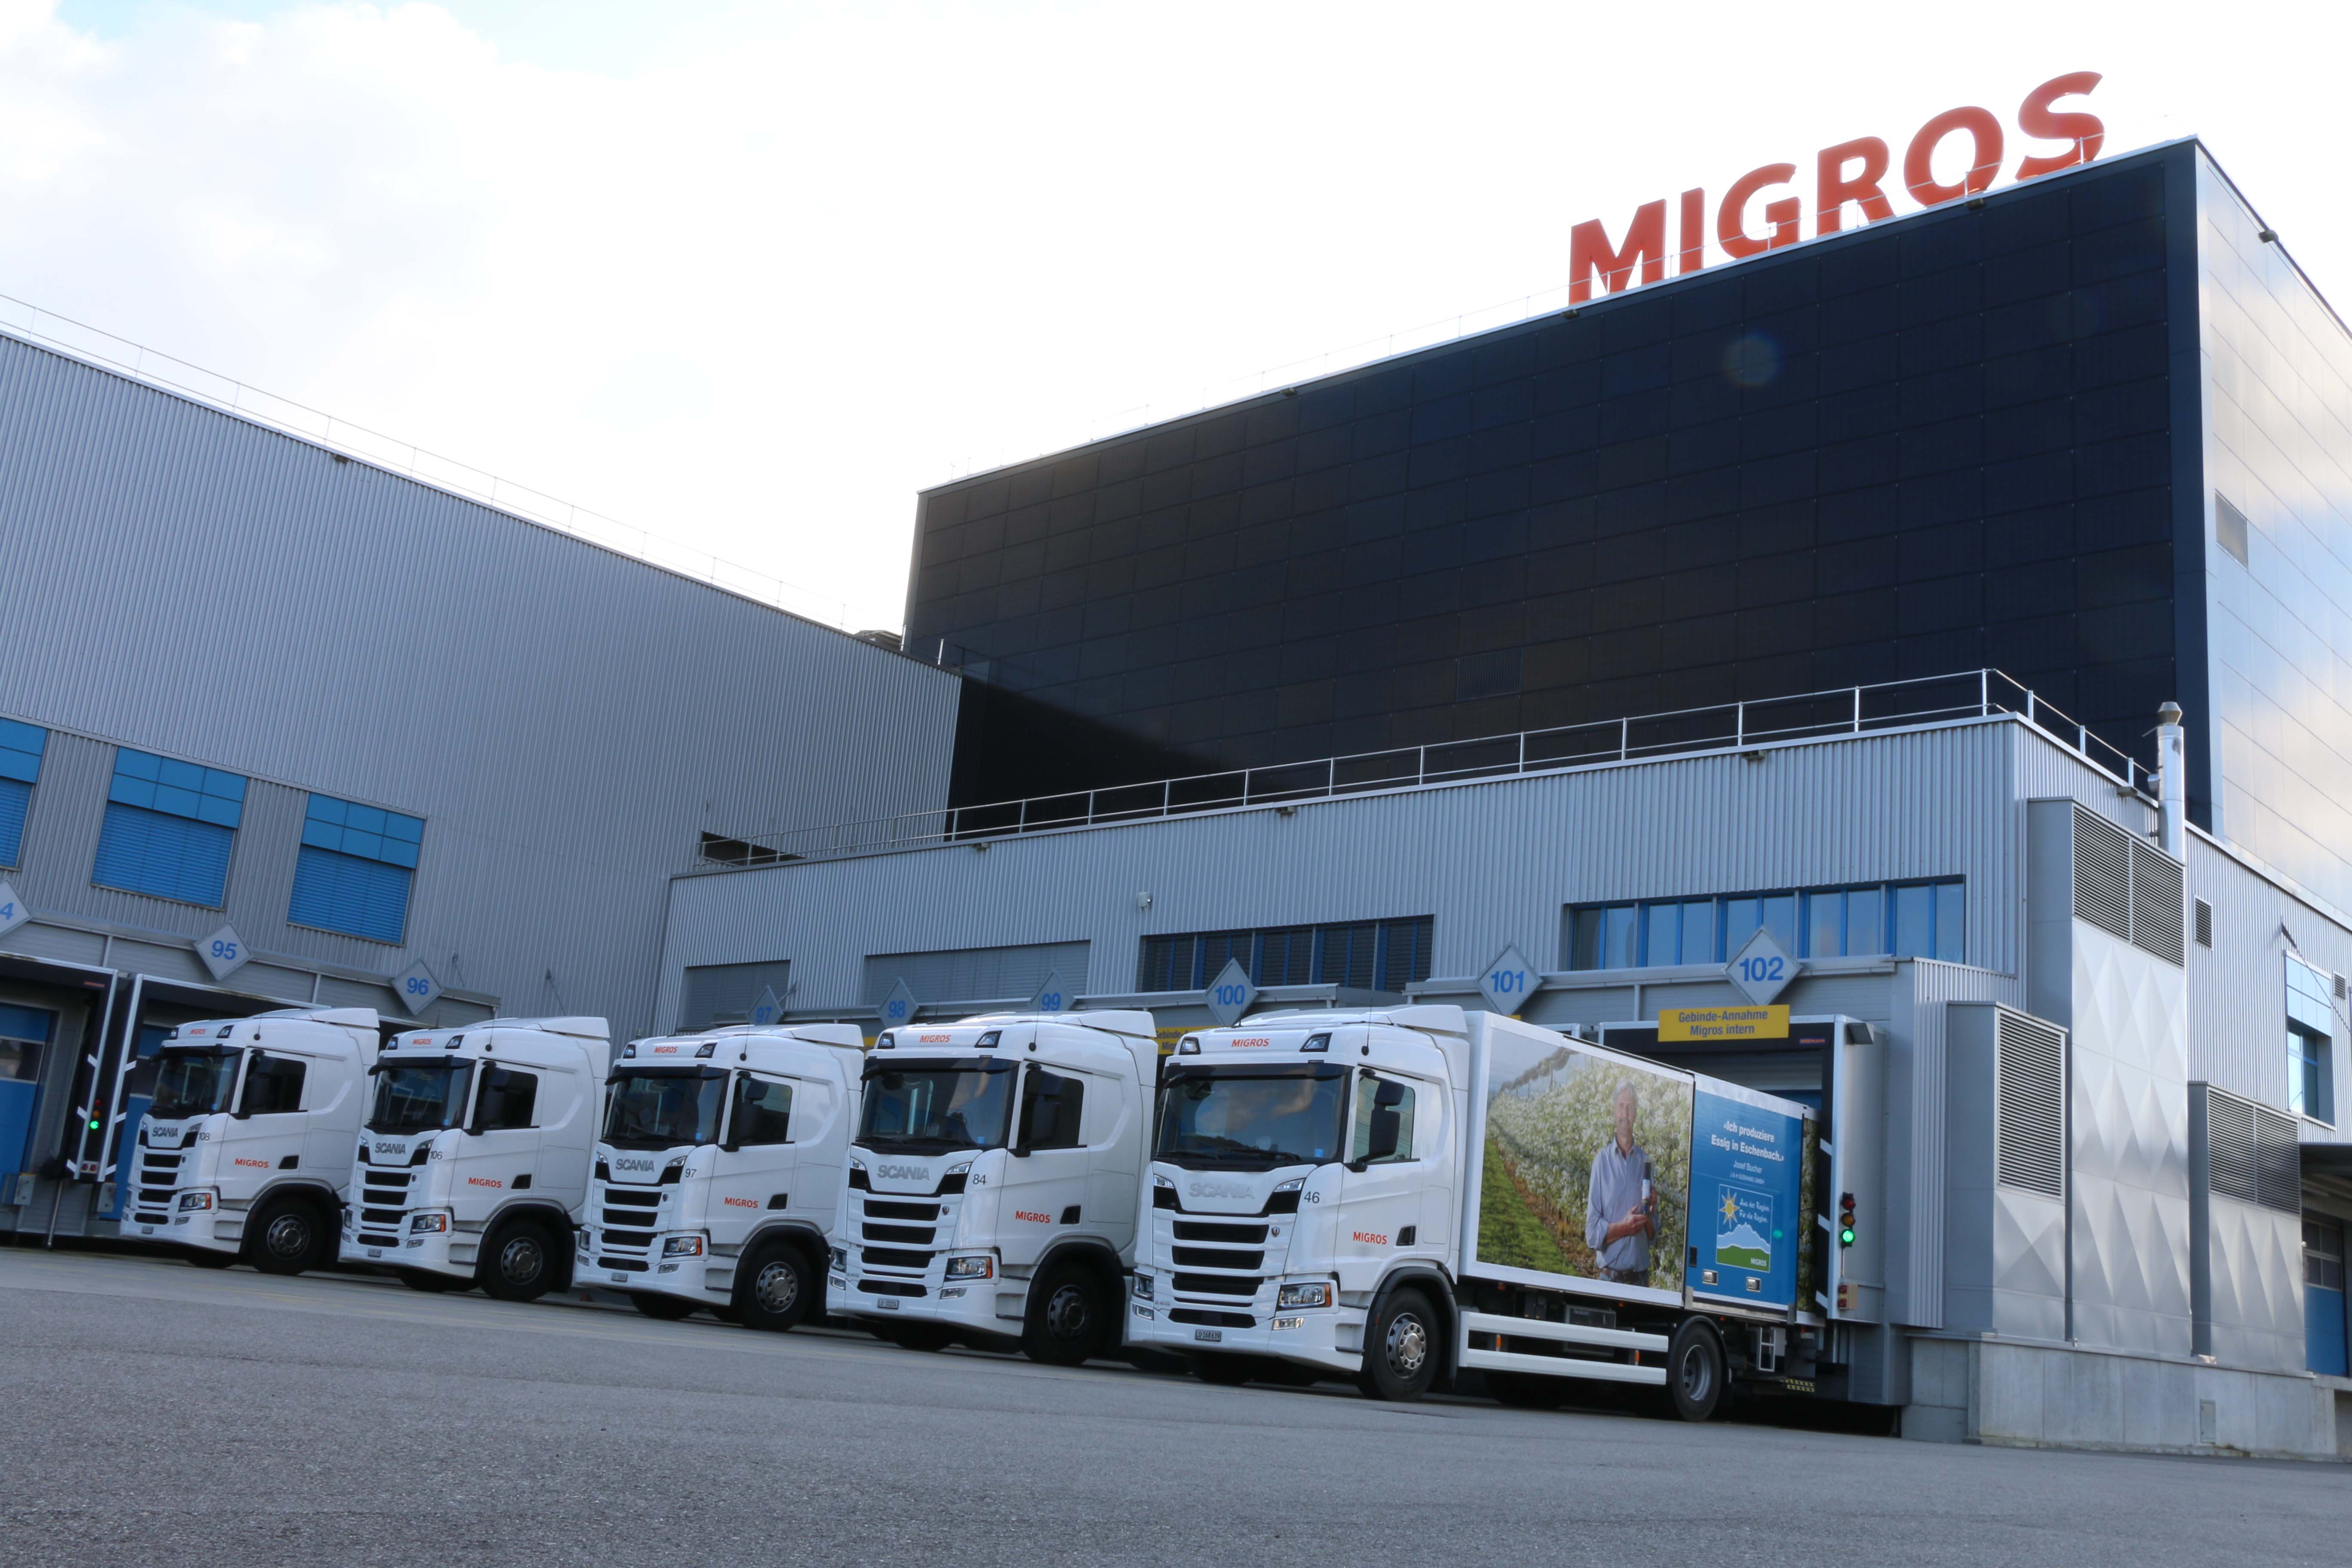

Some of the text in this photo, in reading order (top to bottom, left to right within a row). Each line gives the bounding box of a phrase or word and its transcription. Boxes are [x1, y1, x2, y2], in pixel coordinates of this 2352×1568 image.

[1568, 70, 2105, 305] MIGROS
[211, 940, 237, 960] 95
[1740, 956, 1784, 982] 102
[407, 977, 429, 995] 96
[1491, 970, 1525, 993] 101
[1041, 992, 1061, 1011] 99
[1215, 984, 1245, 1006] 100
[756, 1006, 772, 1023] 97
[888, 1000, 905, 1018] 98
[1679, 1010, 1768, 1023] Gebinde-Annahme
[1690, 1024, 1755, 1037] Migros intern
[919, 1034, 951, 1043] MIGROS
[1231, 1038, 1270, 1047] MIGROS
[152, 1127, 178, 1138] SCANIA
[198, 1132, 210, 1141] 108
[1739, 1127, 1774, 1142] produziere
[375, 1142, 406, 1155] SCANIA
[1711, 1134, 1730, 1151] Essig
[1732, 1139, 1738, 1151] in
[430, 1150, 443, 1160] 106
[235, 1158, 269, 1168] MIGROS
[615, 1158, 655, 1172] SCANIA
[1733, 1160, 1763, 1173] Josef Bucher
[685, 1168, 697, 1178] 97
[877, 1164, 930, 1181] SCANIA
[972, 1173, 986, 1185] 84
[469, 1176, 502, 1188] MIGROS
[1189, 1182, 1256, 1199] SCANIA
[724, 1197, 759, 1208] MIGROS
[1304, 1191, 1320, 1204] 46
[1740, 1198, 1748, 1207] Aus
[1015, 1210, 1051, 1223] MIGROS
[1353, 1231, 1387, 1245] MIGROS
[1750, 1258, 1767, 1267] MIGROS
